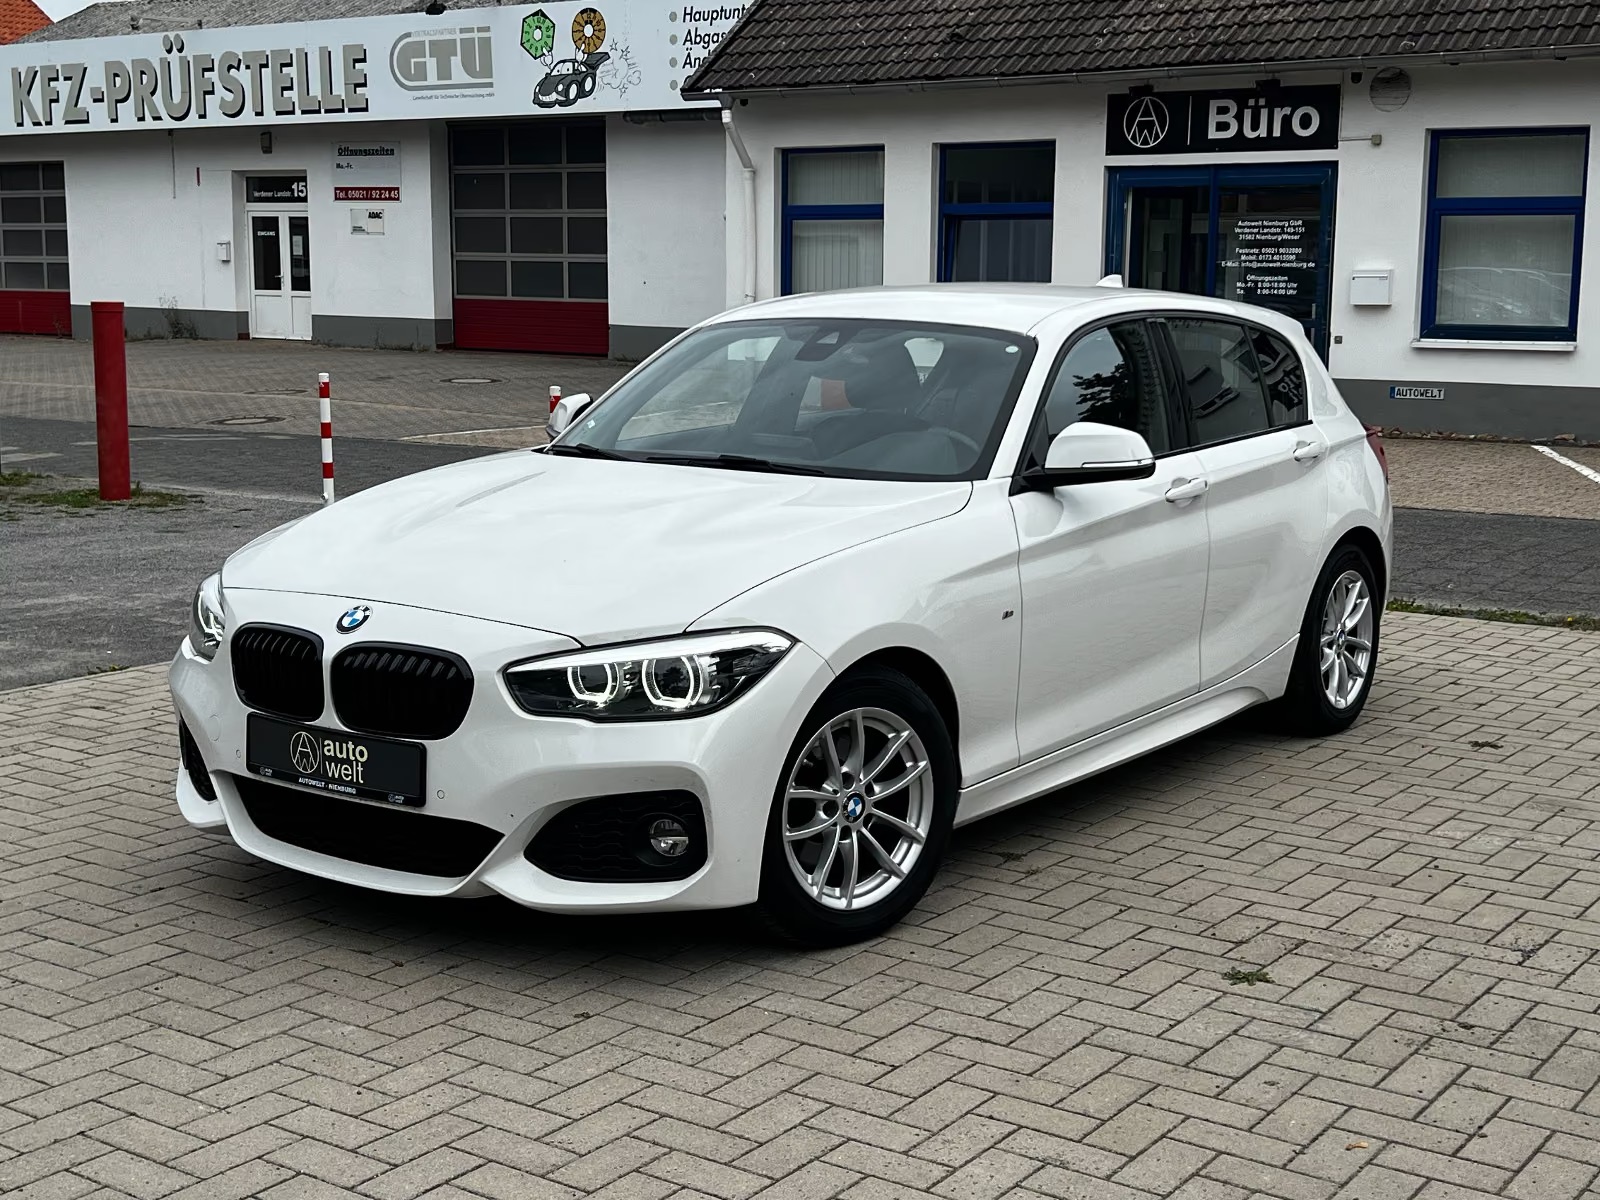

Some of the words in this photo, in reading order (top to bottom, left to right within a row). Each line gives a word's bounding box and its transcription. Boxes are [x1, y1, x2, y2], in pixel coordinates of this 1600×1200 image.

[396, 27, 493, 82] GTÜ
[11, 33, 369, 127] KFZ-PRÜFSTELLE
[1208, 98, 1320, 139] Büro
[337, 144, 395, 157] Öffnungszeiten
[292, 181, 307, 198] 15
[336, 190, 346, 199] Tel.
[347, 190, 367, 199] 05021
[371, 190, 380, 199] 92
[381, 190, 389, 199] 24
[390, 190, 399, 199] 45
[368, 211, 383, 219] ADAC
[1395, 388, 1443, 398] AUTOWELT
[323, 739, 368, 762] auto
[325, 761, 364, 784] welt
[298, 777, 325, 788] AUTOWELT
[328, 783, 357, 794] NIENBURG
